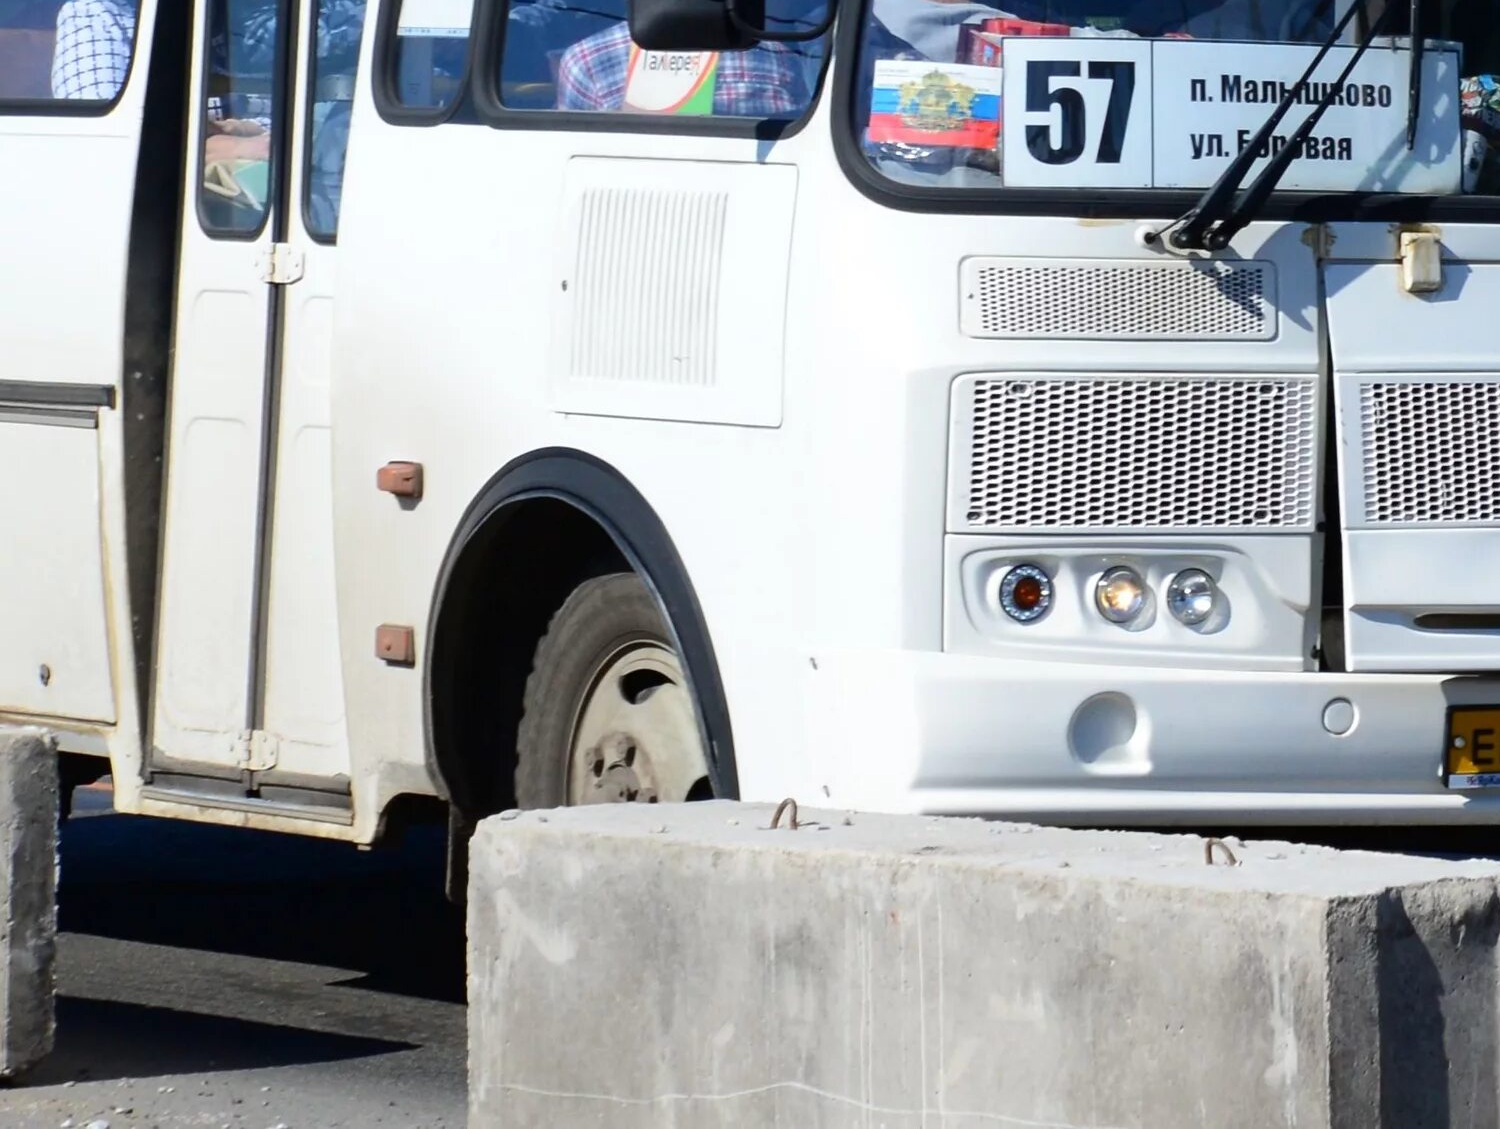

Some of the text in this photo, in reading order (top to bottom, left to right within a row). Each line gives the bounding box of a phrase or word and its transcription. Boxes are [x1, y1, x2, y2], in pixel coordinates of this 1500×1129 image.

[1190, 78, 1213, 103] п.
[1025, 60, 1136, 165] 57
[1190, 133, 1230, 160] ул.
